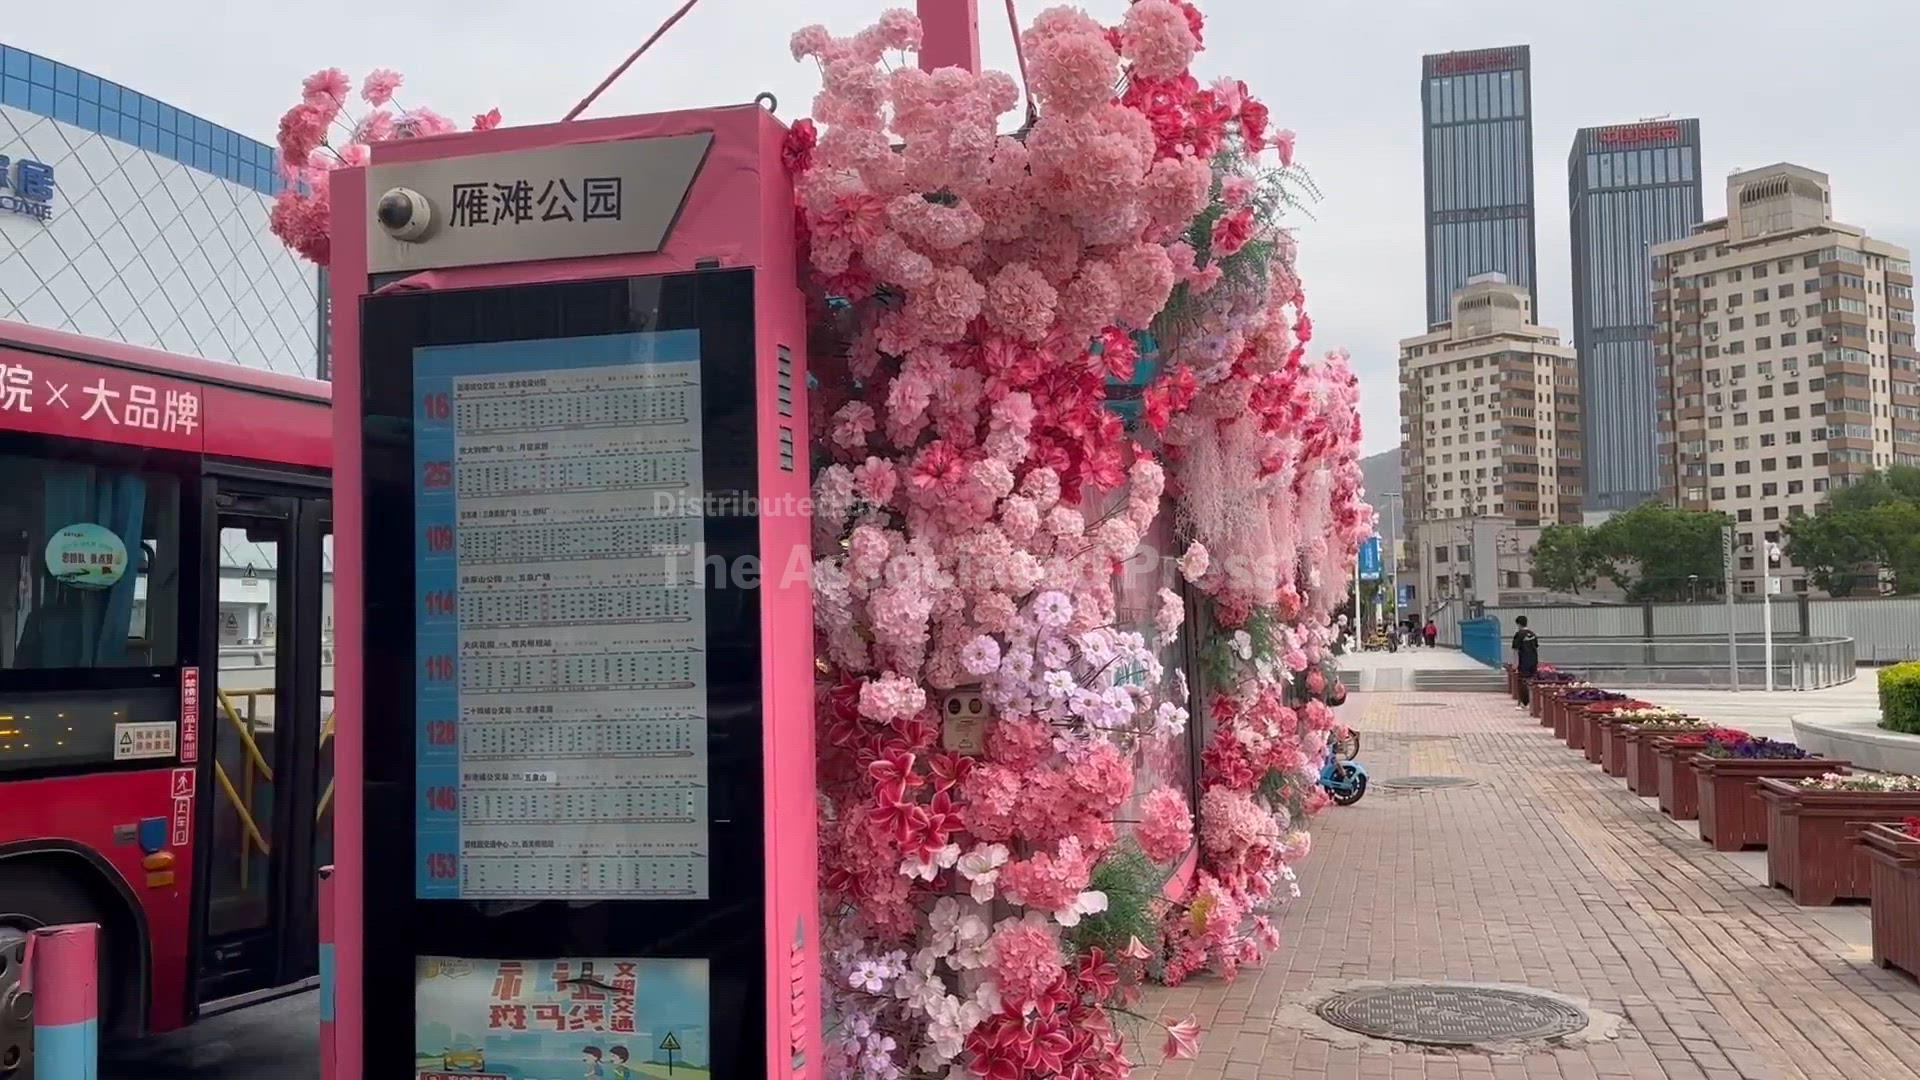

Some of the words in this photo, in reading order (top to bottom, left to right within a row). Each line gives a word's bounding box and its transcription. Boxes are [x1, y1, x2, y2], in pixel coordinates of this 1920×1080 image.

[449, 176, 622, 228] 雁滩公园
[80, 377, 199, 436] 大品牌
[424, 392, 450, 419] 16
[424, 460, 453, 488] 25
[425, 525, 454, 553] 109
[426, 852, 457, 879] 153
[609, 961, 637, 1034] 文明交通
[489, 1003, 605, 1033] 斑马线
